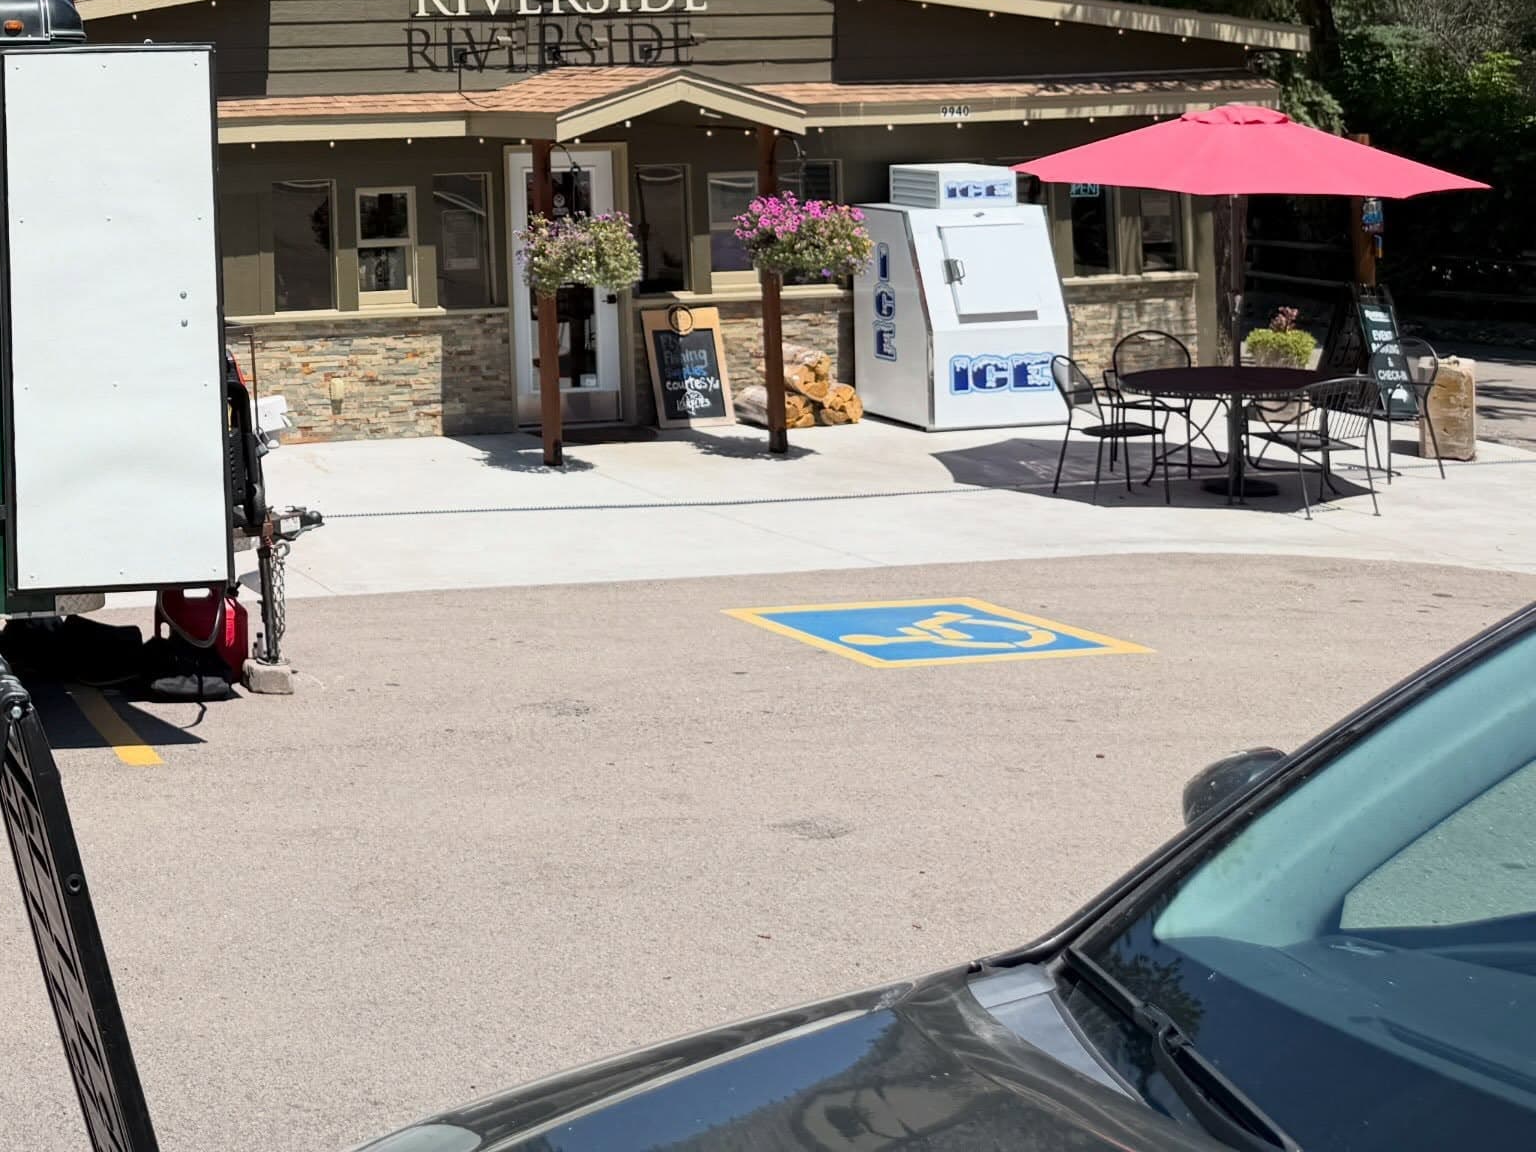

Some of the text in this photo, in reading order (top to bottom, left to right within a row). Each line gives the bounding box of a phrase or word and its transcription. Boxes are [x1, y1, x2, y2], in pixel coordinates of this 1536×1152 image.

[941, 105, 969, 117] 9940
[945, 181, 1011, 198] ICE
[874, 242, 896, 361] ICE
[951, 354, 1053, 393] ICE
